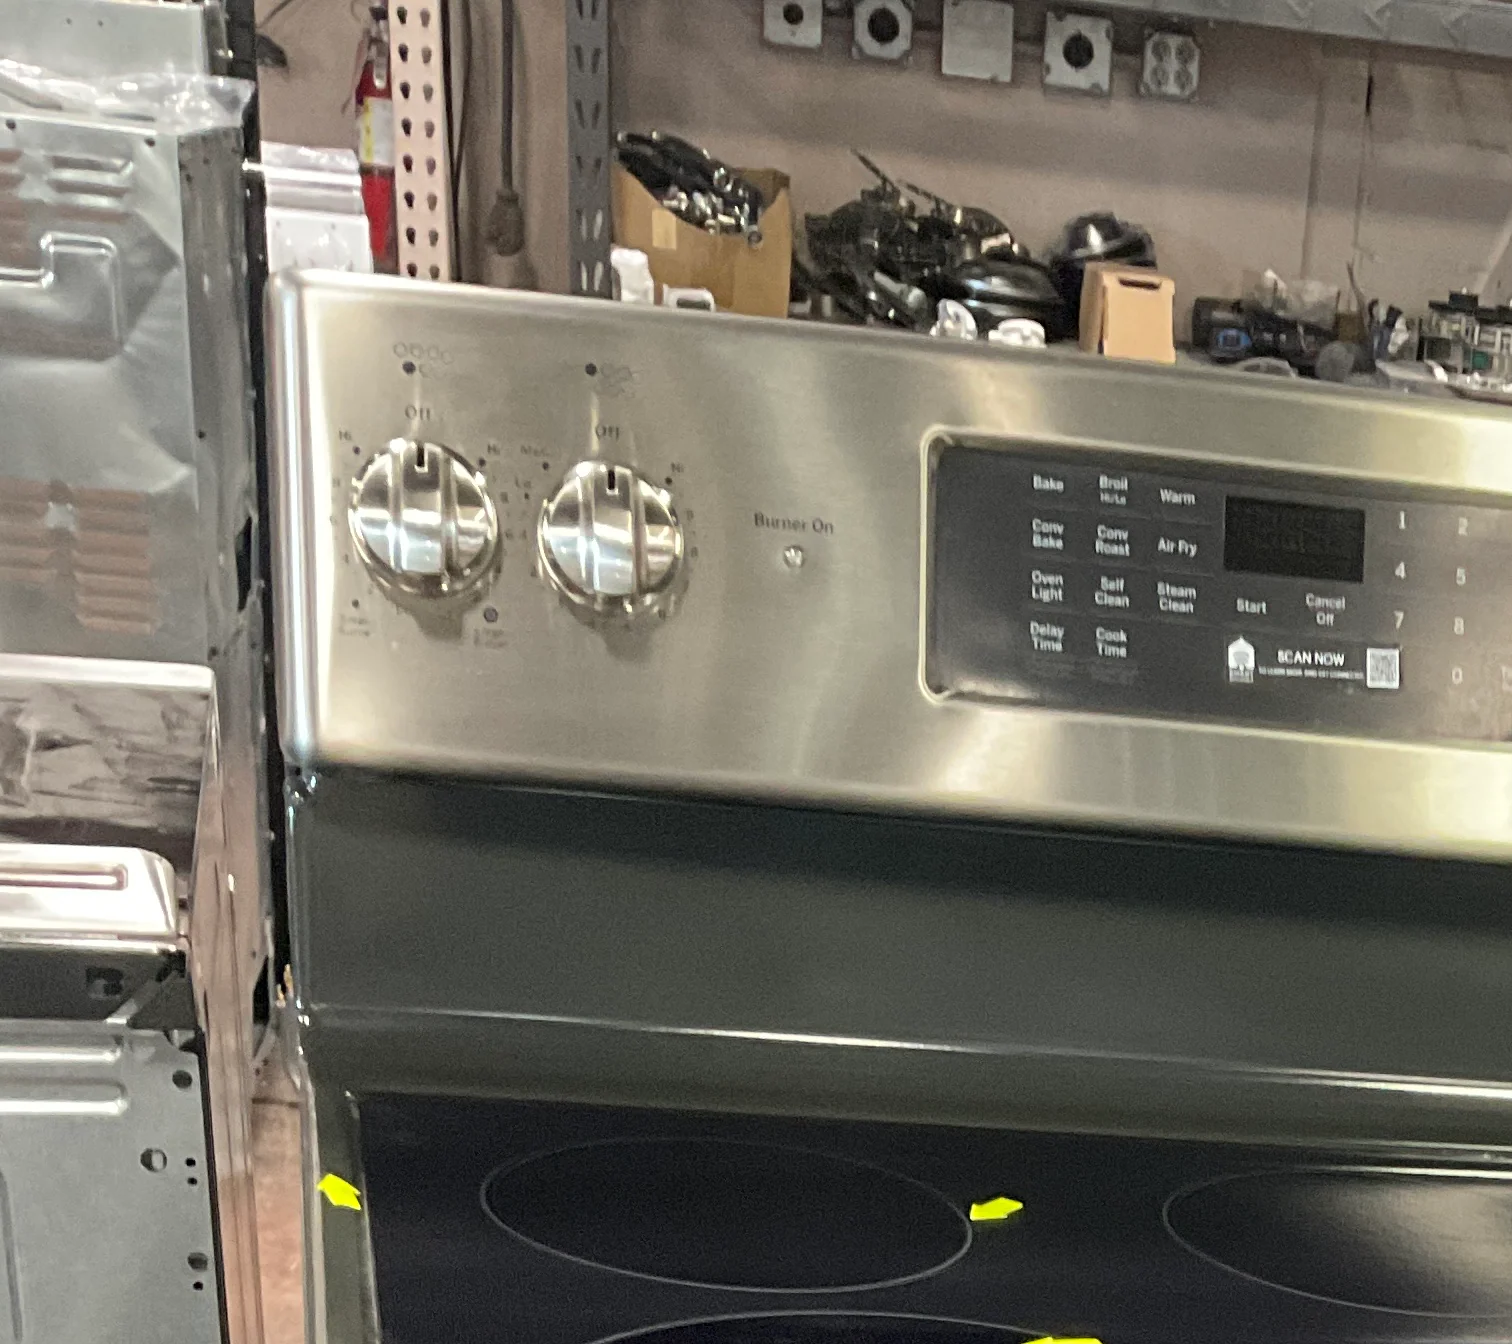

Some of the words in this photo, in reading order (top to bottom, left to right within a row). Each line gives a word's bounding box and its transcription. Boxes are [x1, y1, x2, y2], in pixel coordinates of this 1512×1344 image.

[1033, 474, 1064, 493] Bake
[1099, 474, 1128, 491] Broil
[1160, 488, 1196, 505] Warm
[754, 512, 808, 534] Burner
[812, 518, 835, 535] On
[1032, 518, 1064, 535] Conv
[1398, 510, 1407, 529] 1
[1032, 533, 1064, 550] Bake
[1097, 524, 1129, 541] Conv
[1157, 536, 1175, 553] Air
[1178, 539, 1198, 558] Fry
[1031, 569, 1064, 586] Oven
[1394, 561, 1407, 580] 4
[1031, 584, 1063, 602] Light
[1094, 590, 1130, 607] Clean
[1157, 581, 1197, 600] Steam
[1159, 596, 1194, 613] Clean
[1236, 597, 1267, 615] Start
[1305, 592, 1346, 611] Cancel
[1316, 611, 1335, 626] Off
[1394, 610, 1404, 629] 7
[1030, 620, 1065, 640] Delay
[1096, 626, 1128, 643] Cook
[1032, 635, 1063, 652] Time
[1096, 640, 1127, 658] Time
[1277, 648, 1312, 666] SCAN
[1314, 650, 1345, 667] NOW
